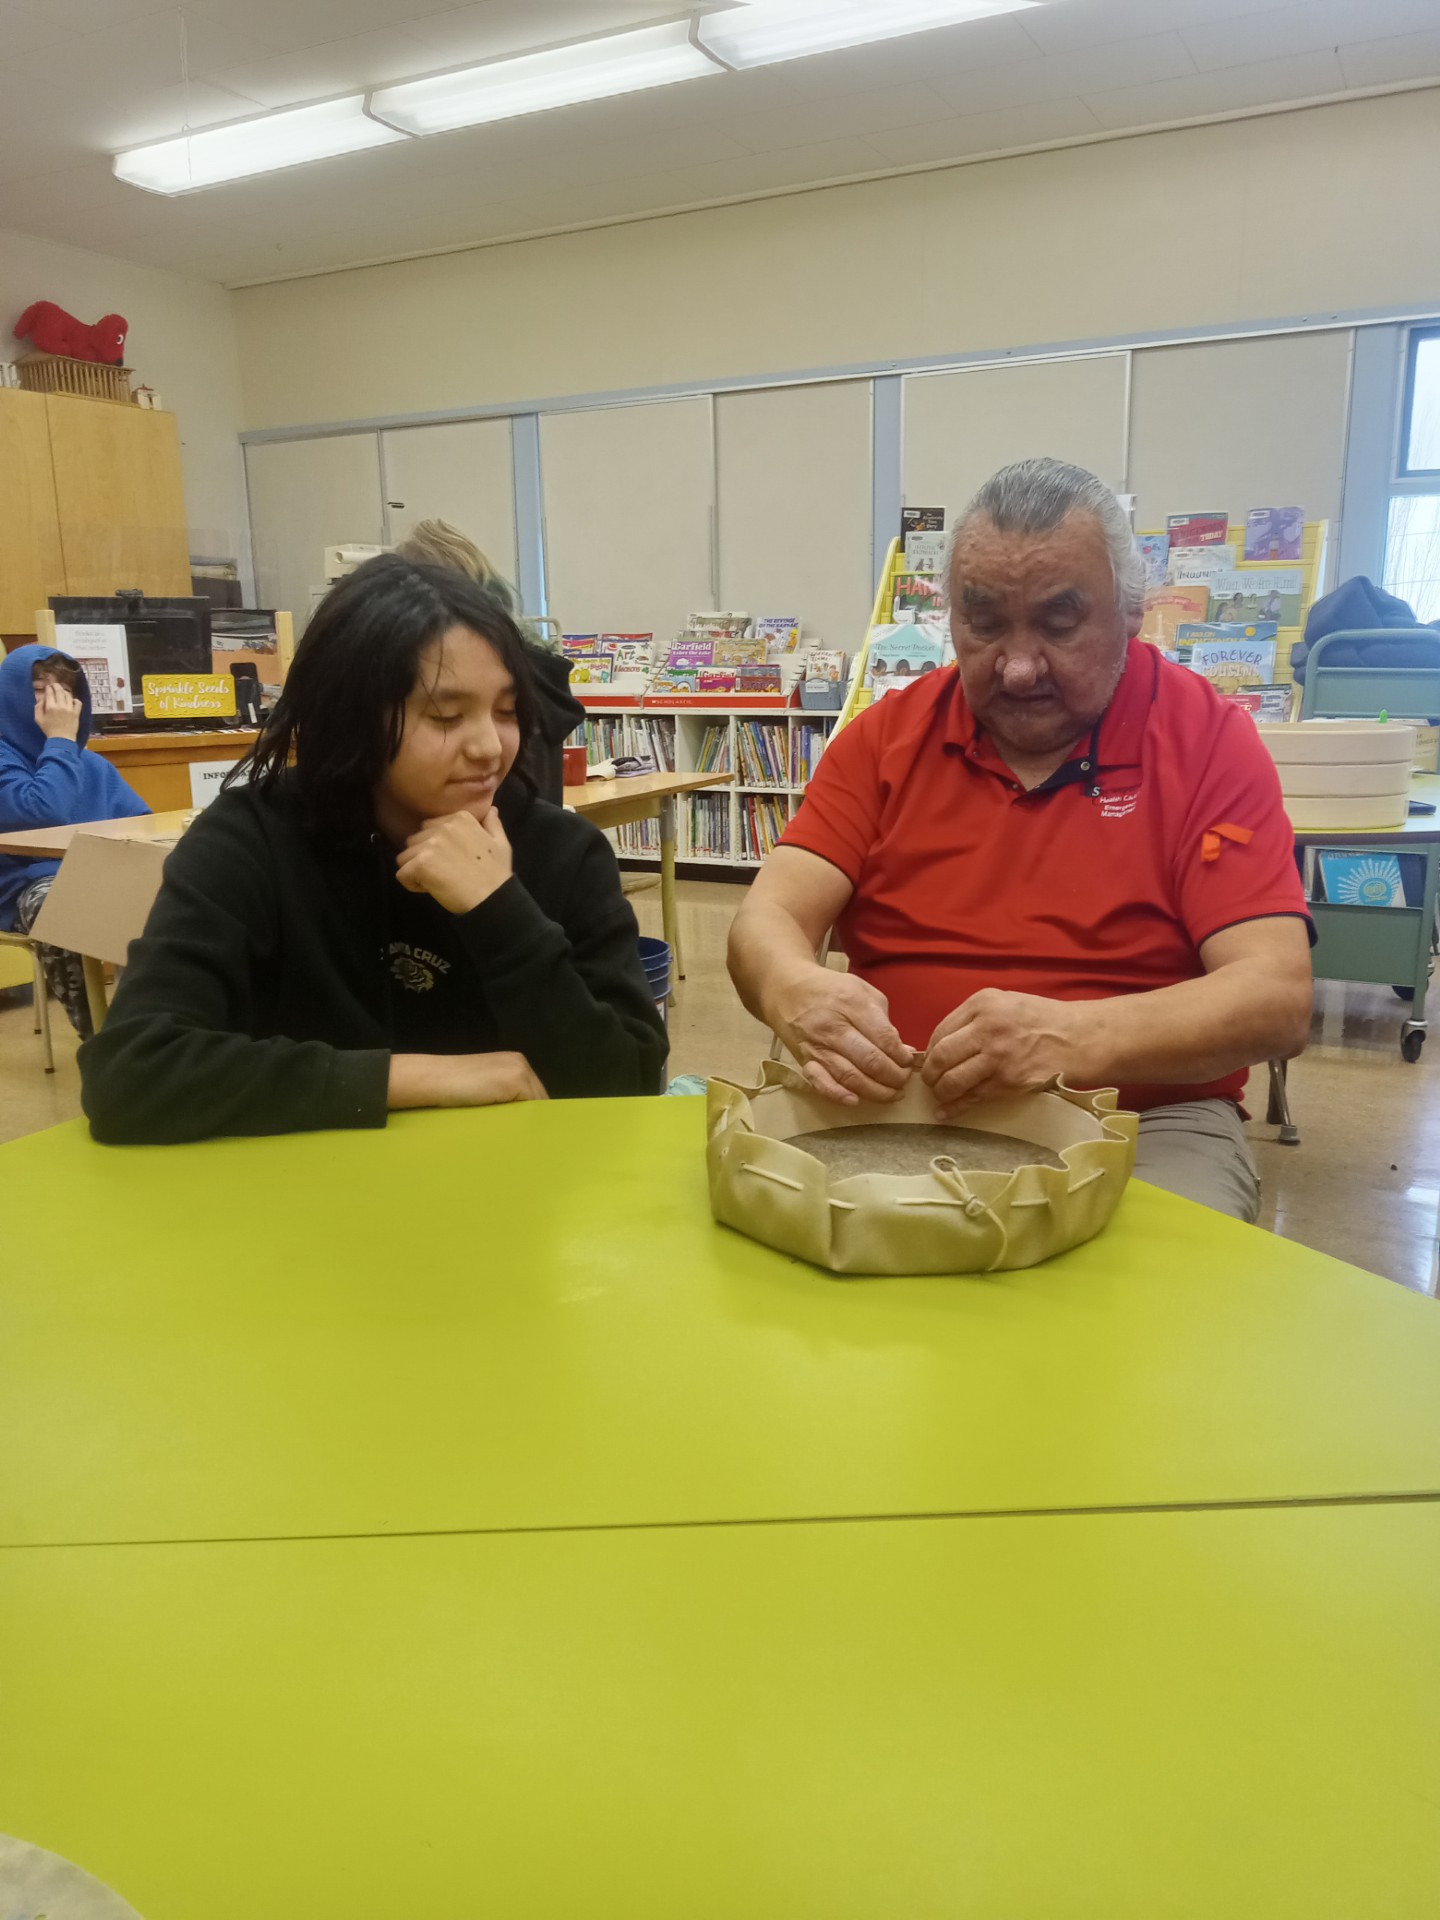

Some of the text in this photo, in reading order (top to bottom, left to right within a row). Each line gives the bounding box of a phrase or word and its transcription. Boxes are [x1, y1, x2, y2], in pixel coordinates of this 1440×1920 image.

[616, 649, 636, 662] Art
[1202, 649, 1263, 666] FOREVER
[1201, 664, 1260, 678] COUSINS
[147, 680, 230, 697] Sprinkle Seeds
[160, 695, 222, 710] of Kindness
